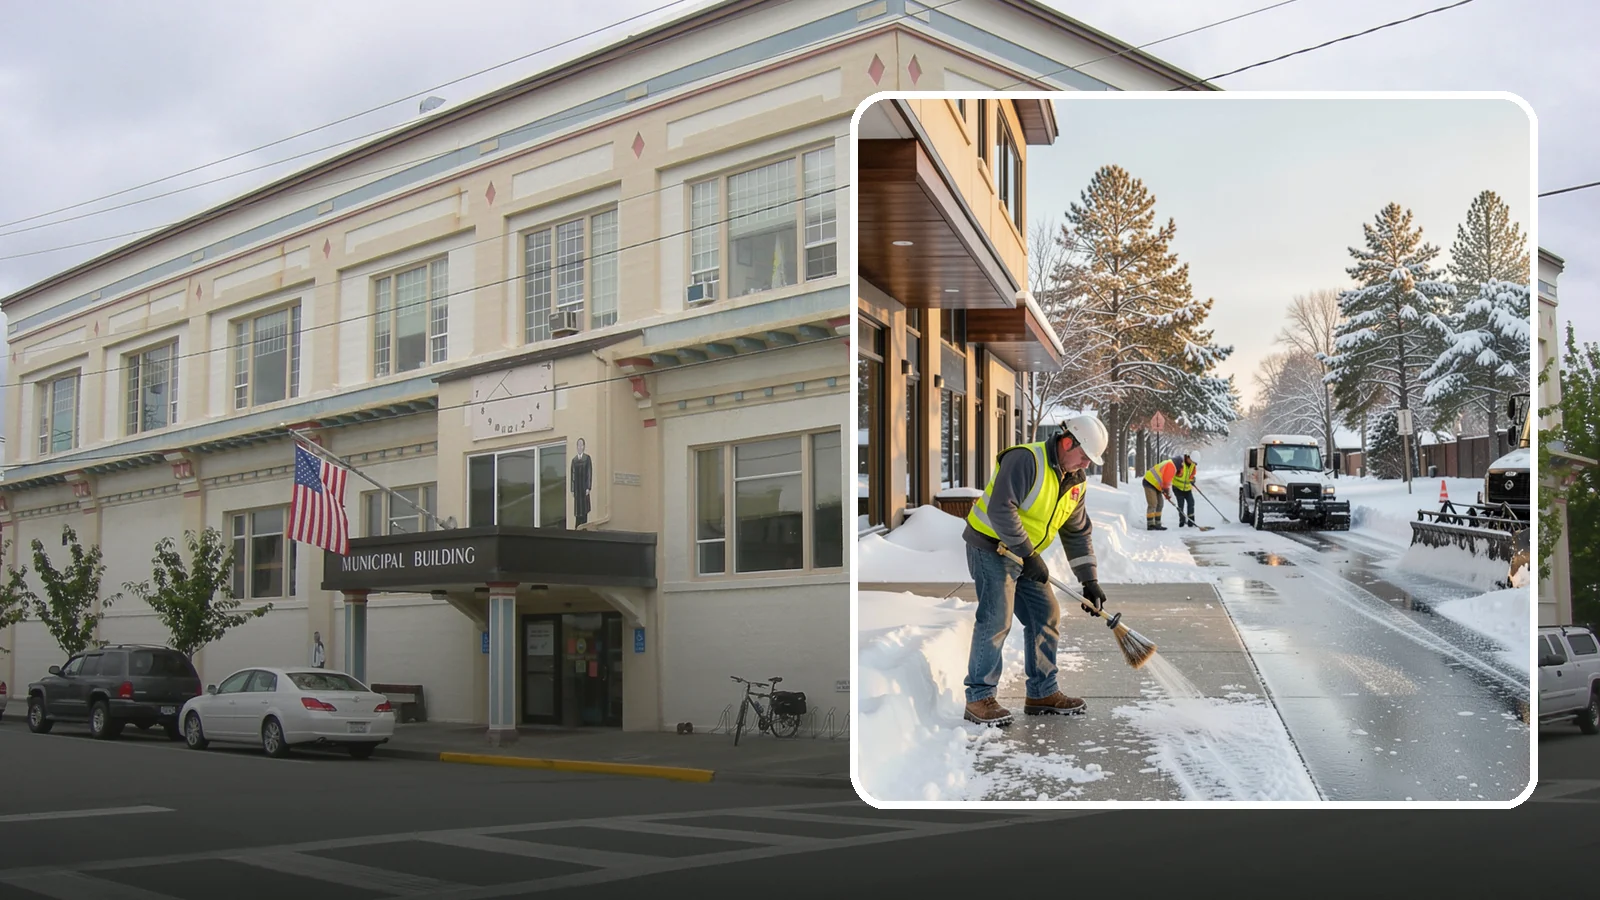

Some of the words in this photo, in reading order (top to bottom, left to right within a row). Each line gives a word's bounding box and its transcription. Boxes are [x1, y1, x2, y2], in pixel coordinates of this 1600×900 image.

[475, 390, 479, 398] 7
[481, 407, 485, 415] 8
[488, 417, 492, 426] 9
[495, 423, 500, 432] 10
[508, 425, 513, 433] 12
[521, 420, 526, 428] 2
[529, 414, 533, 422] 3
[536, 402, 540, 410] 4
[342, 552, 405, 572] MUNICIPAL
[414, 546, 475, 567] BUILDING
